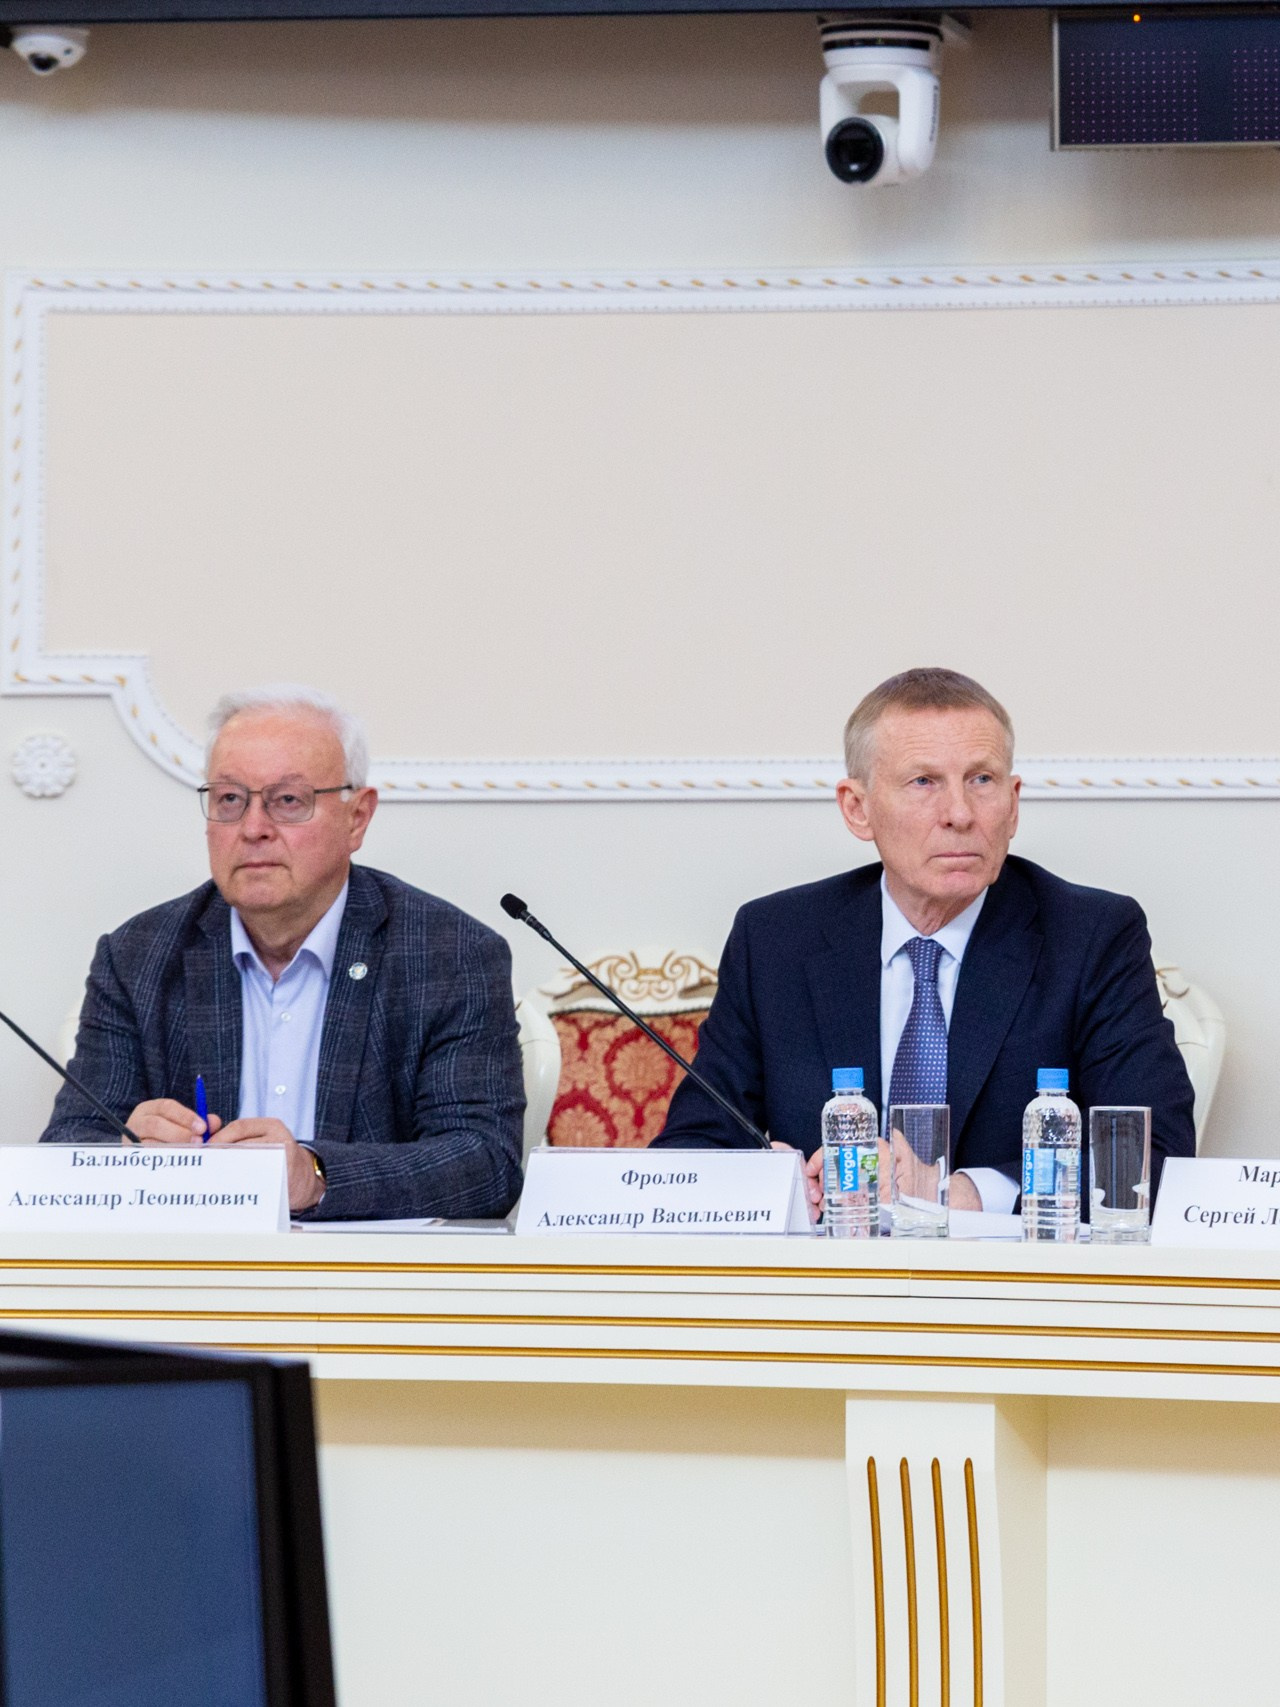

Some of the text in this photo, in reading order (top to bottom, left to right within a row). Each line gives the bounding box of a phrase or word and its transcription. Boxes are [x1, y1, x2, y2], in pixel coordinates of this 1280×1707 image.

[71, 1150, 204, 1171] Балыбердин
[842, 1147, 856, 1191] Vorgol
[1024, 1149, 1033, 1192] Vorgol
[620, 1169, 699, 1190] Фролов
[8, 1188, 259, 1210] Александр Леонидович
[537, 1207, 772, 1229] Александр Васильевич
[1183, 1205, 1256, 1228] Сергей
